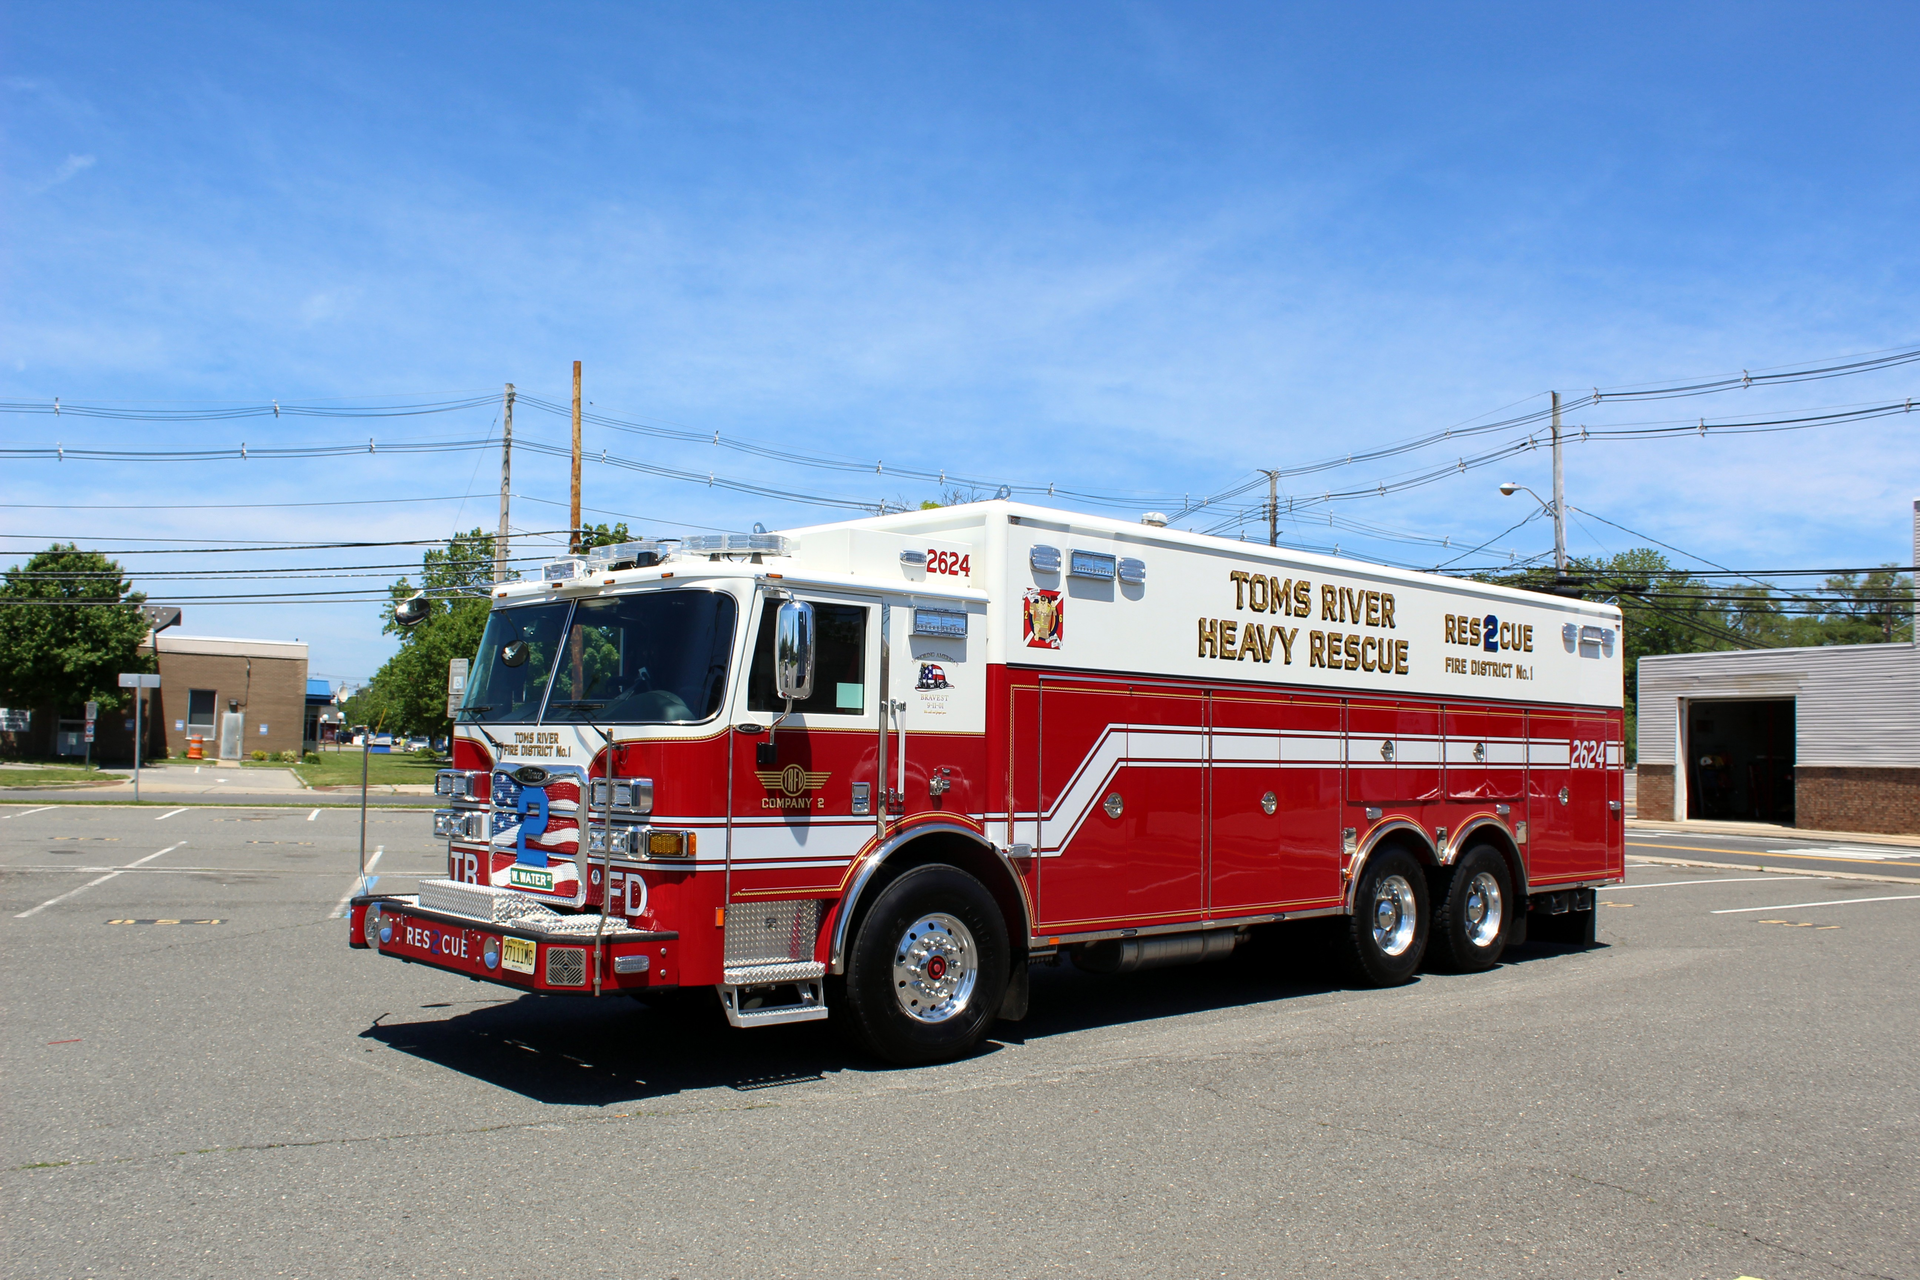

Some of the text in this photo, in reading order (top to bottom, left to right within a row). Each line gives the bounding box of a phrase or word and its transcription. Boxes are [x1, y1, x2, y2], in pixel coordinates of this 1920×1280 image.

[927, 548, 971, 577] 2624
[1230, 569, 1396, 629] TOMS RIVER
[1198, 617, 1409, 675] HEAVY RESCUE
[1445, 613, 1533, 653] RES2CUE
[1445, 656, 1467, 674] FIRE
[1471, 659, 1513, 679] DISTRICT
[920, 693, 949, 701] BRAVEST
[504, 744, 519, 756] FIRE
[521, 744, 553, 757] DISTRICT
[514, 732, 559, 744] TOMS RIVER
[1570, 739, 1605, 769] 2624
[784, 768, 804, 792] TRFD
[761, 797, 825, 809] COMPANY 2
[517, 786, 549, 868] 2
[451, 851, 478, 886] TR
[511, 870, 519, 882] W.
[520, 871, 546, 886] WATER
[608, 870, 648, 917] FD
[406, 926, 469, 958] RES2CUE
